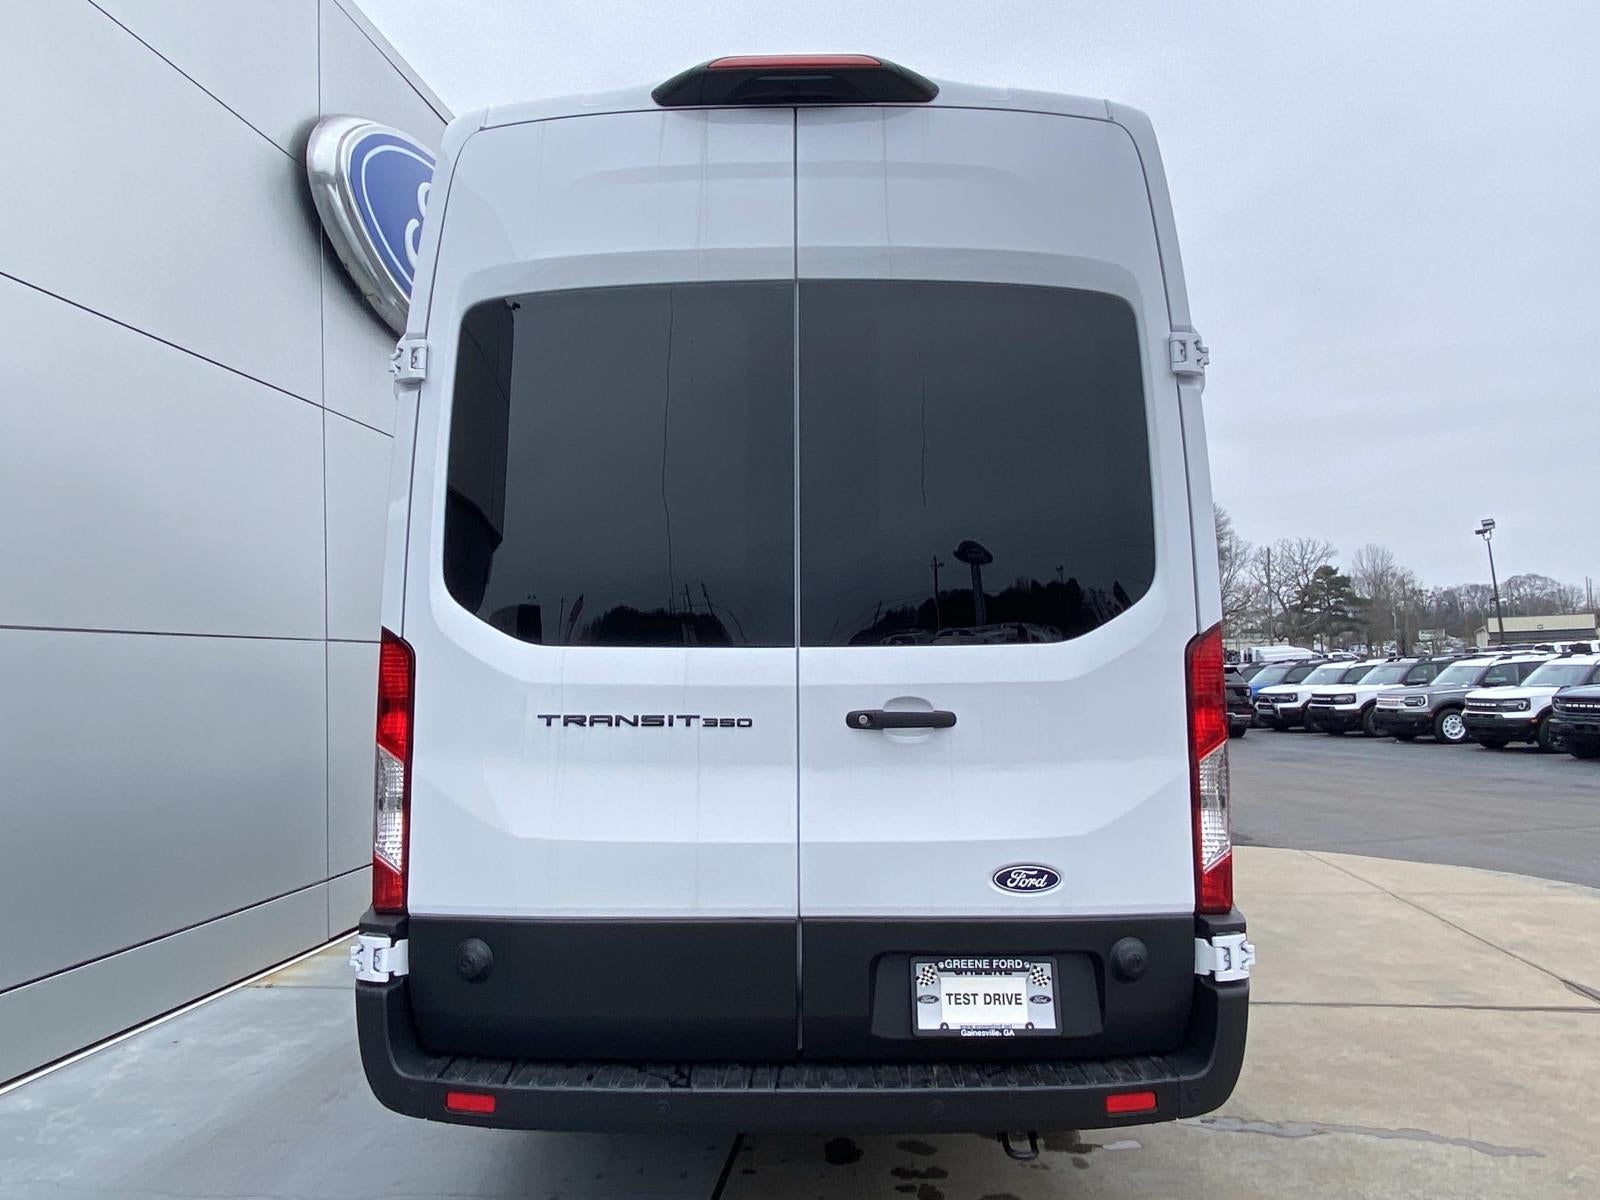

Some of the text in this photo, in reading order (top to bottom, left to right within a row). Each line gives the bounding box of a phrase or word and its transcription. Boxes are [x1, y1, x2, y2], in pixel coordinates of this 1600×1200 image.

[537, 713, 753, 728] TRANSIT 350
[1006, 869, 1048, 888] Ford
[944, 958, 1023, 969] GREENE FORD
[945, 992, 1023, 1006] TEST DRIVE
[1003, 1028, 1015, 1037] GA
